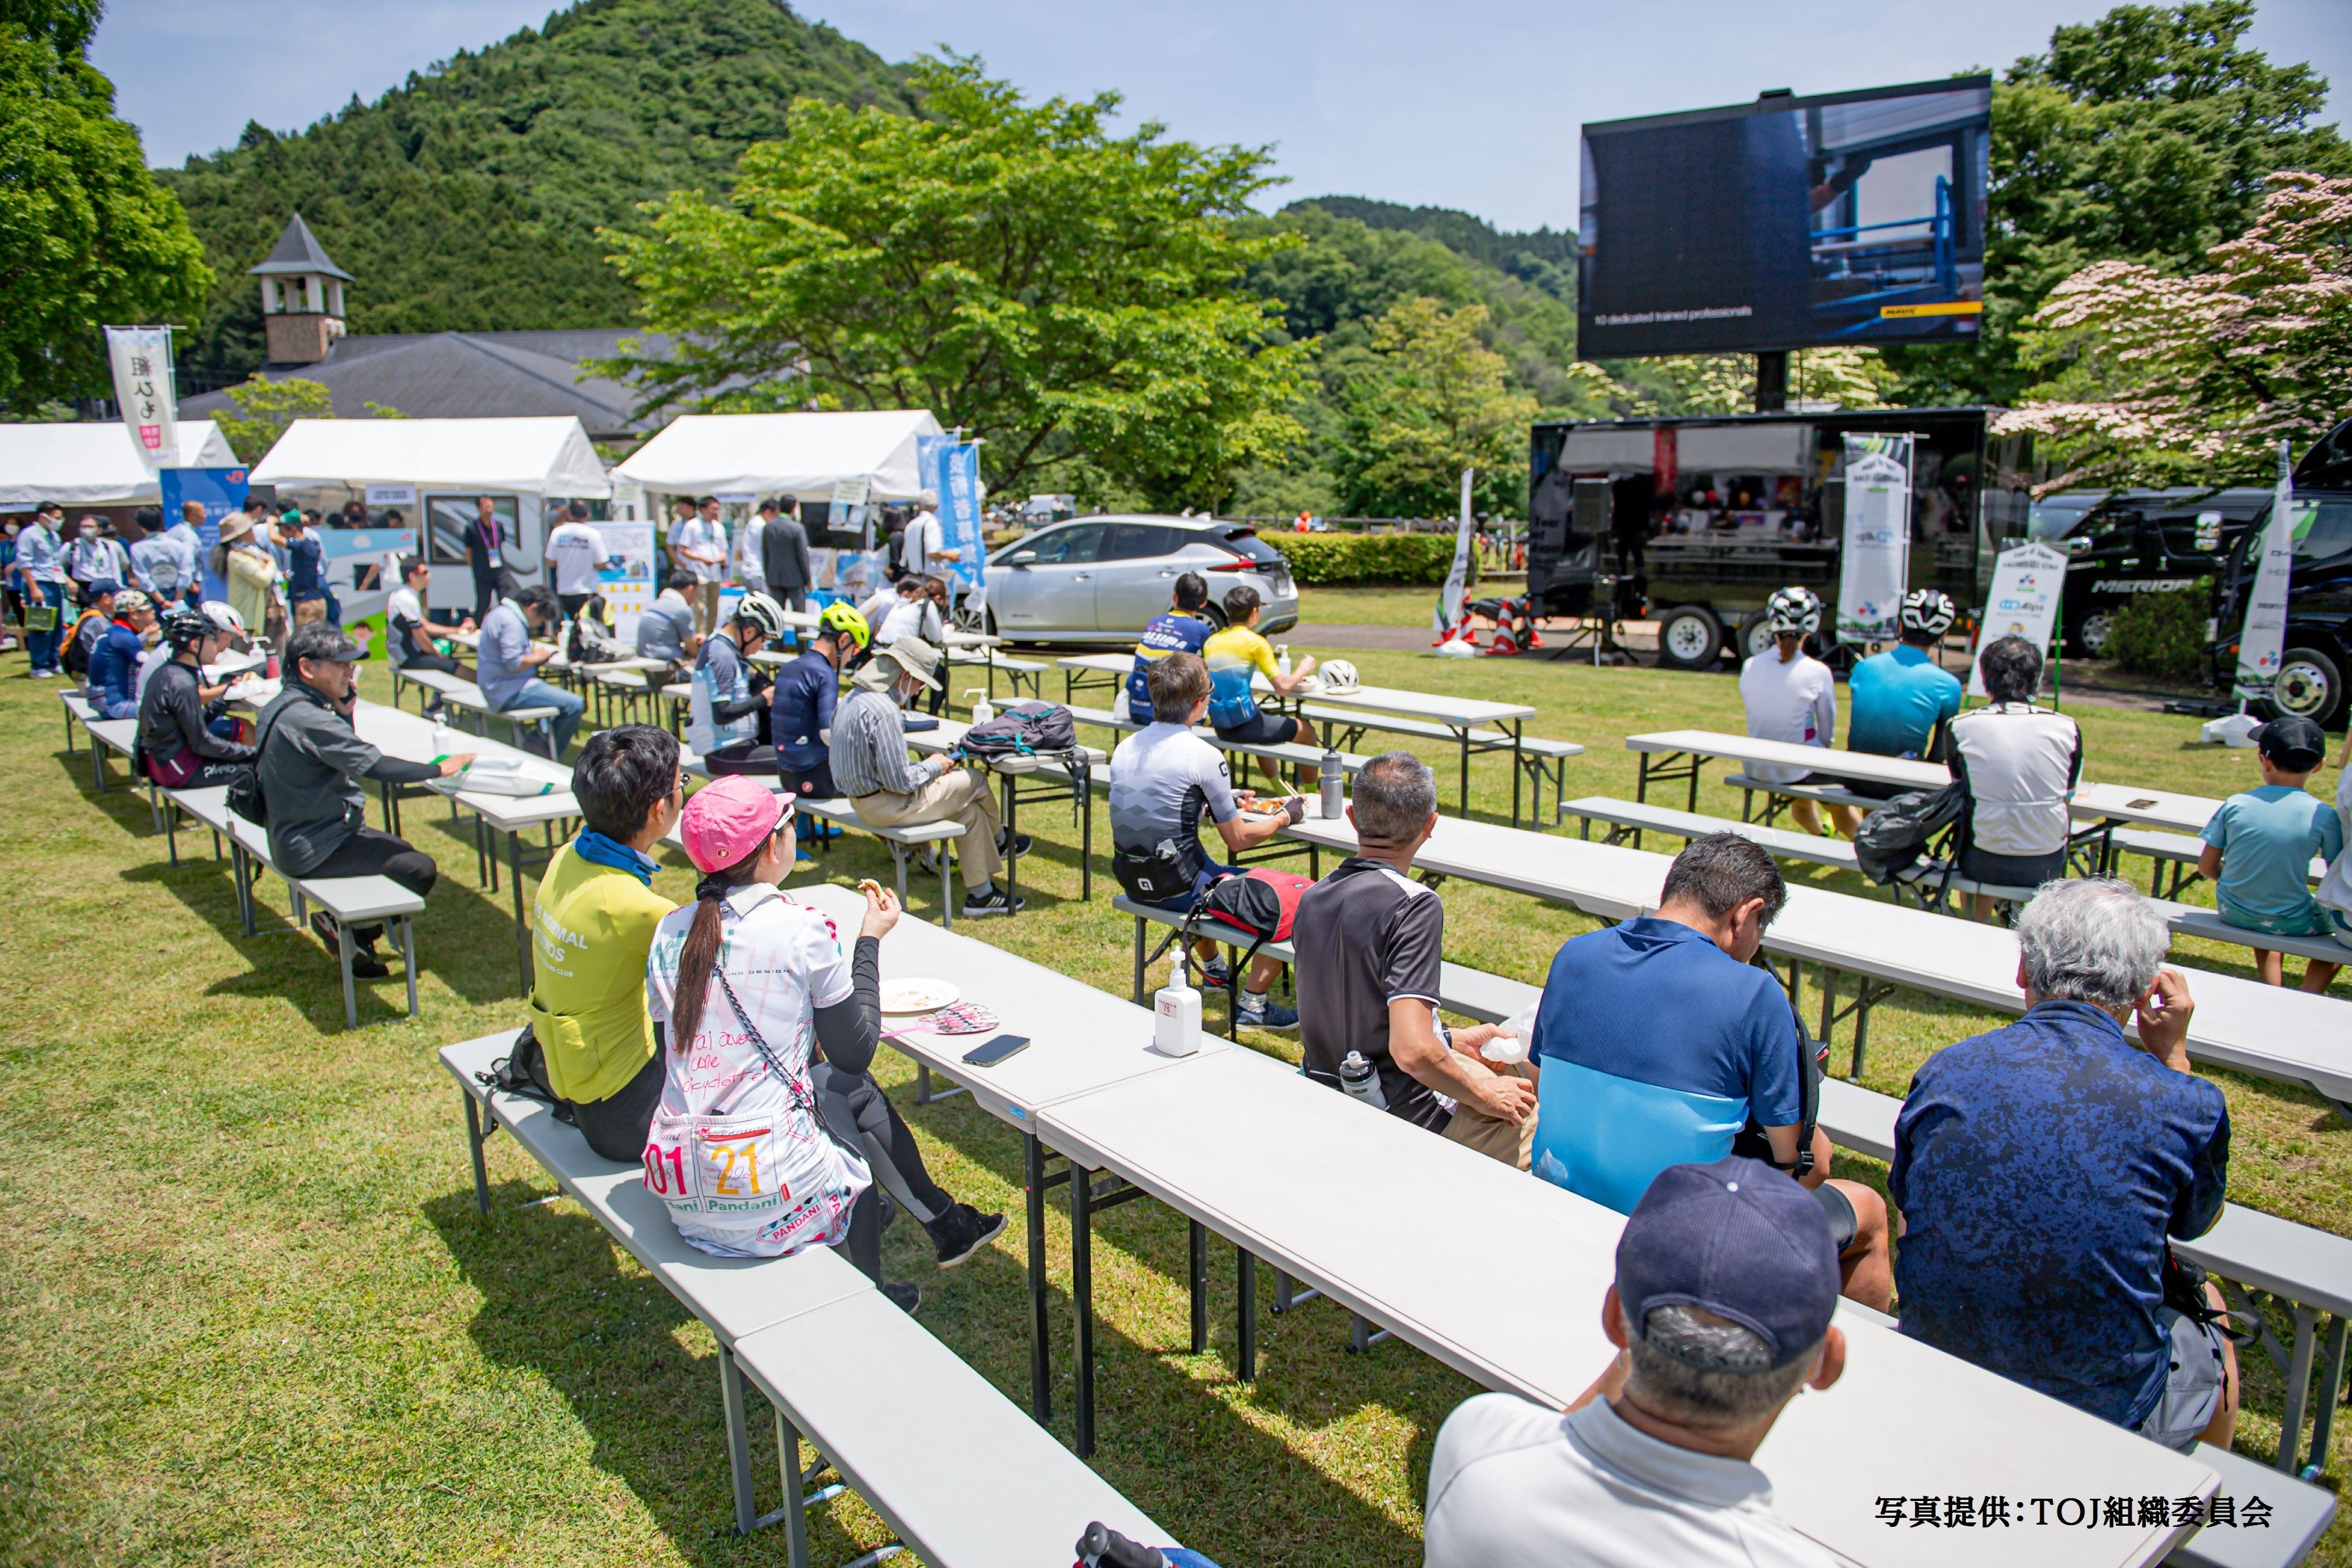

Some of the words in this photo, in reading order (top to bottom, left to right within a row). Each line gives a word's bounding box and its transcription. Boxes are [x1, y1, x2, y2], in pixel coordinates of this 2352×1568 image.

[1607, 311, 1654, 326] dedicated
[1655, 309, 1688, 322] trained
[1689, 305, 1753, 321] professionals
[226, 470, 245, 484] JR
[541, 910, 589, 950] NORMAL
[557, 968, 574, 978] CLUB
[710, 1142, 760, 1195] 21
[708, 1195, 778, 1212] Pandani
[773, 1203, 821, 1241] PANDANI
